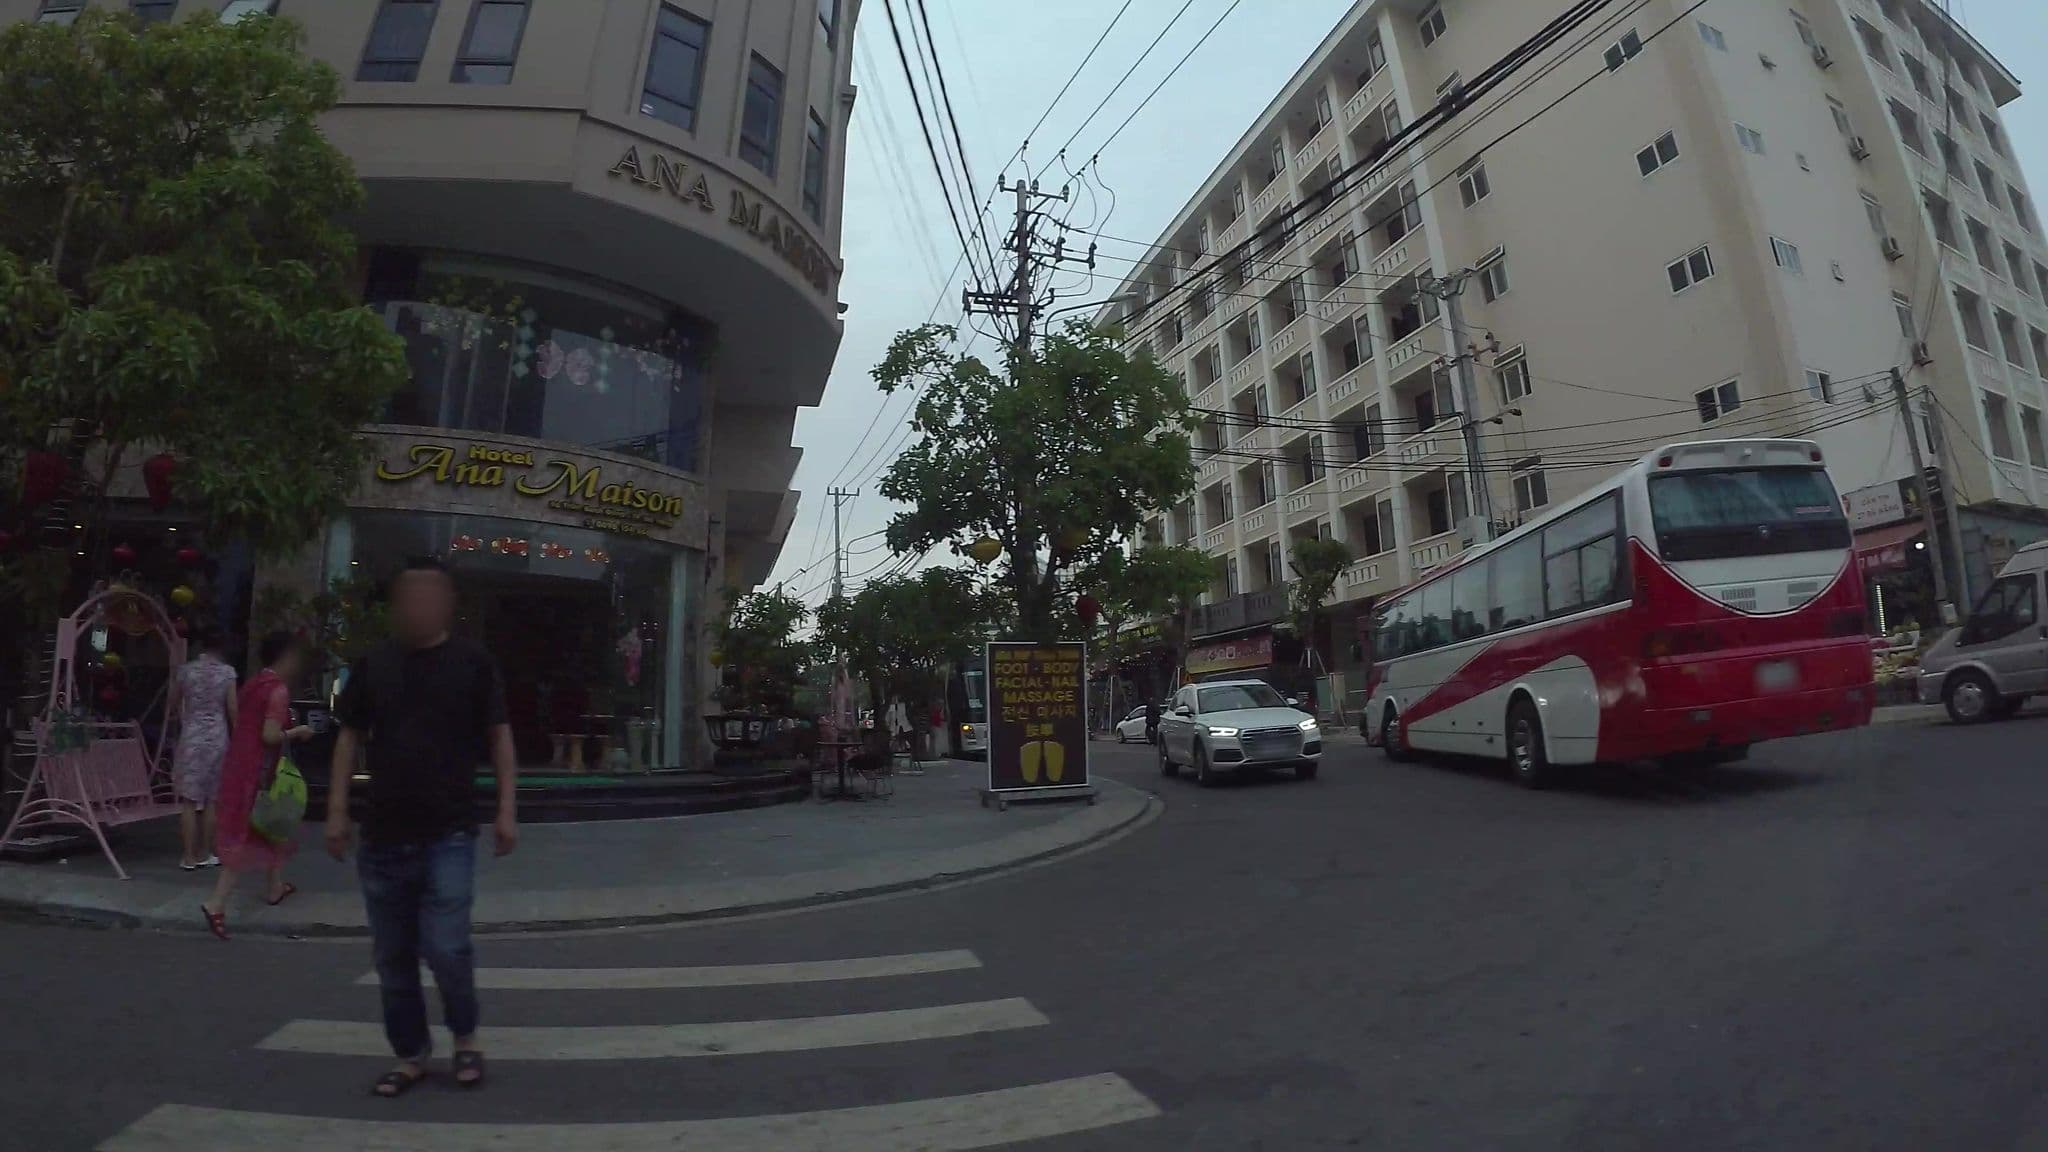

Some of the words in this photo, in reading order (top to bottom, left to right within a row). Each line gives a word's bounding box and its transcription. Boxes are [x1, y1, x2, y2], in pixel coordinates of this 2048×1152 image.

[608, 144, 716, 212] ANA
[468, 444, 535, 467] Hotel
[375, 444, 505, 487] Ana
[514, 459, 684, 518] Maison
[995, 663, 1028, 674] FOOT
[1043, 662, 1079, 674] BODY
[1003, 690, 1074, 704] MASSAGE
